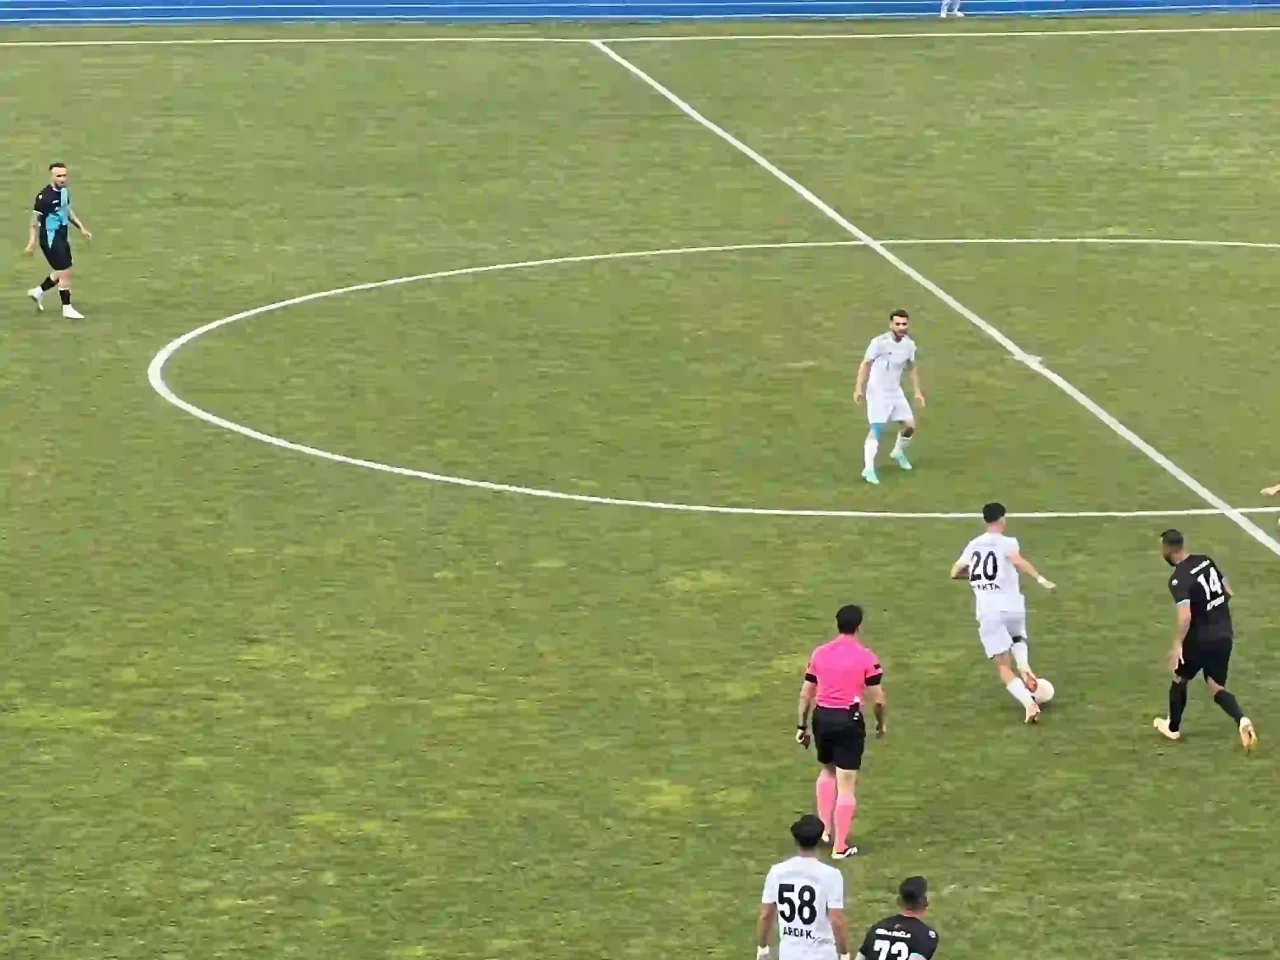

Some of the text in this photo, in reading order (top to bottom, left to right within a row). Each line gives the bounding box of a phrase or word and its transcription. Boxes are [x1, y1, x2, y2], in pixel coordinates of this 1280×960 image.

[970, 550, 998, 582] 20
[1196, 566, 1223, 601] 14
[777, 883, 818, 926] 58
